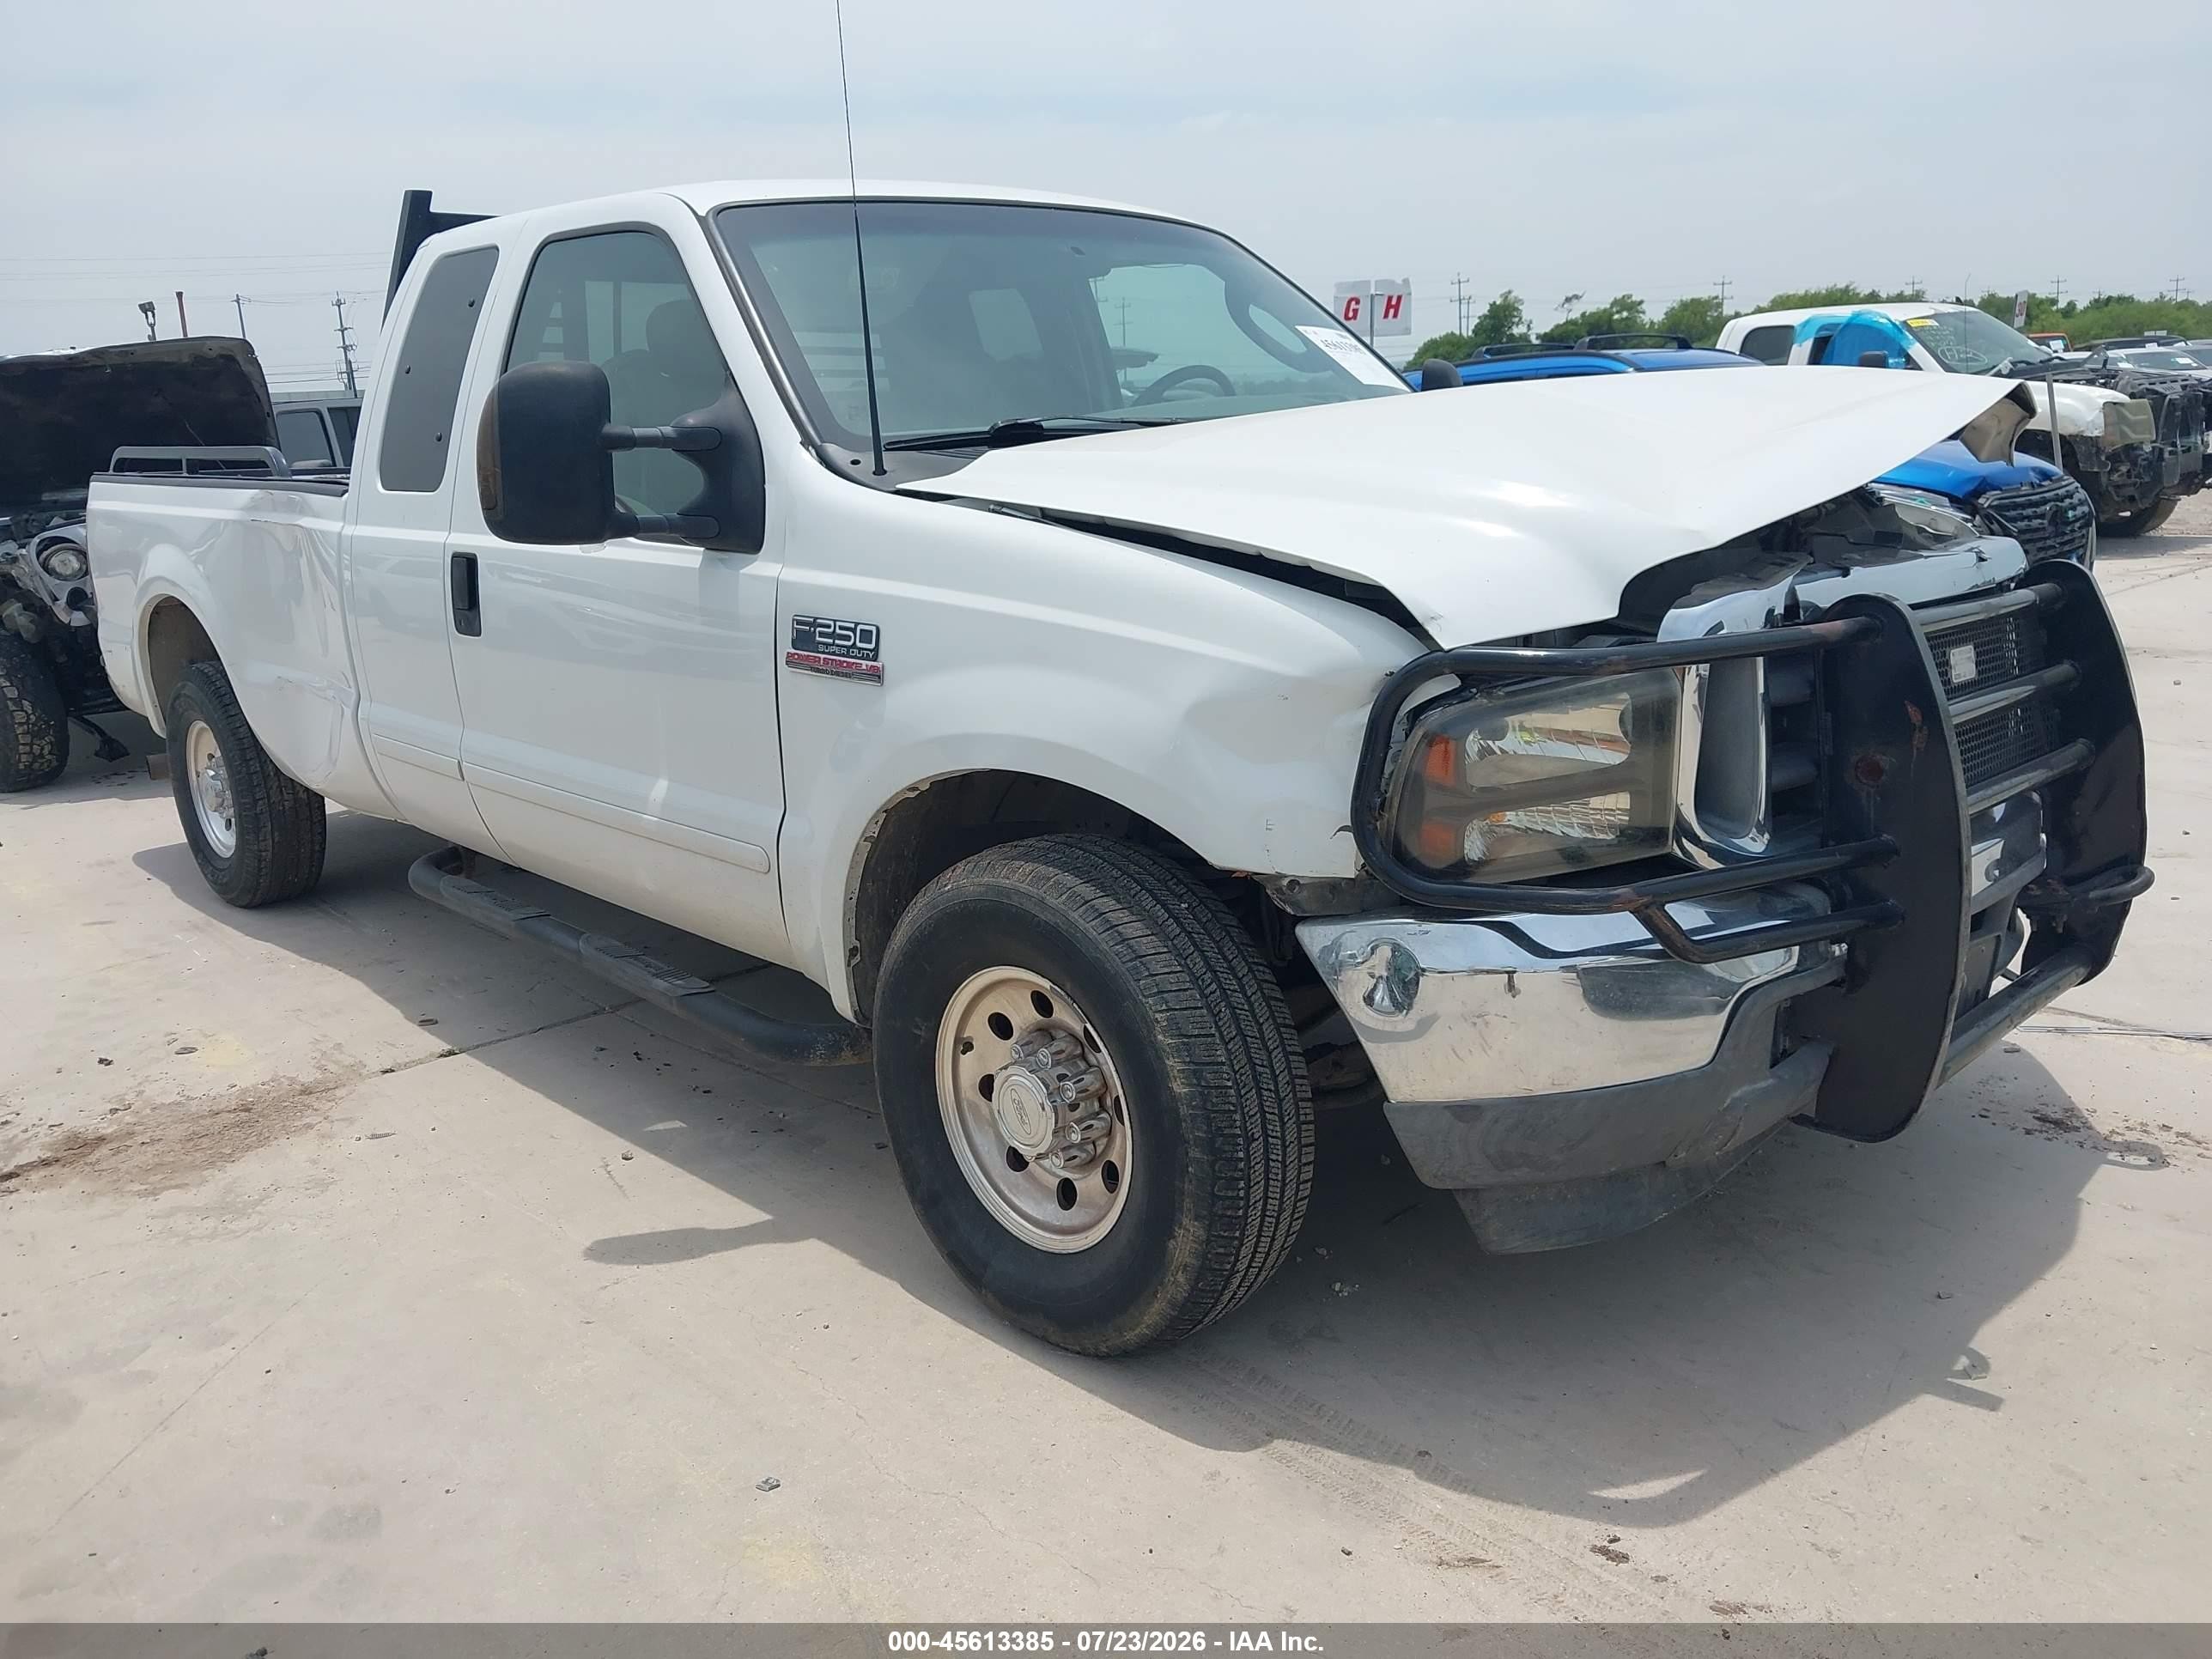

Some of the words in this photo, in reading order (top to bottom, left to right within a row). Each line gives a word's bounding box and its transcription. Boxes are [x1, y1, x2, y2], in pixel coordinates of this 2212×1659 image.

[1344, 296, 1361, 321] G
[1382, 295, 1403, 319] H
[787, 652, 821, 667] POWER
[822, 657, 863, 671] STROKE
[817, 644, 848, 655] SUPER
[849, 648, 875, 659] DUTY
